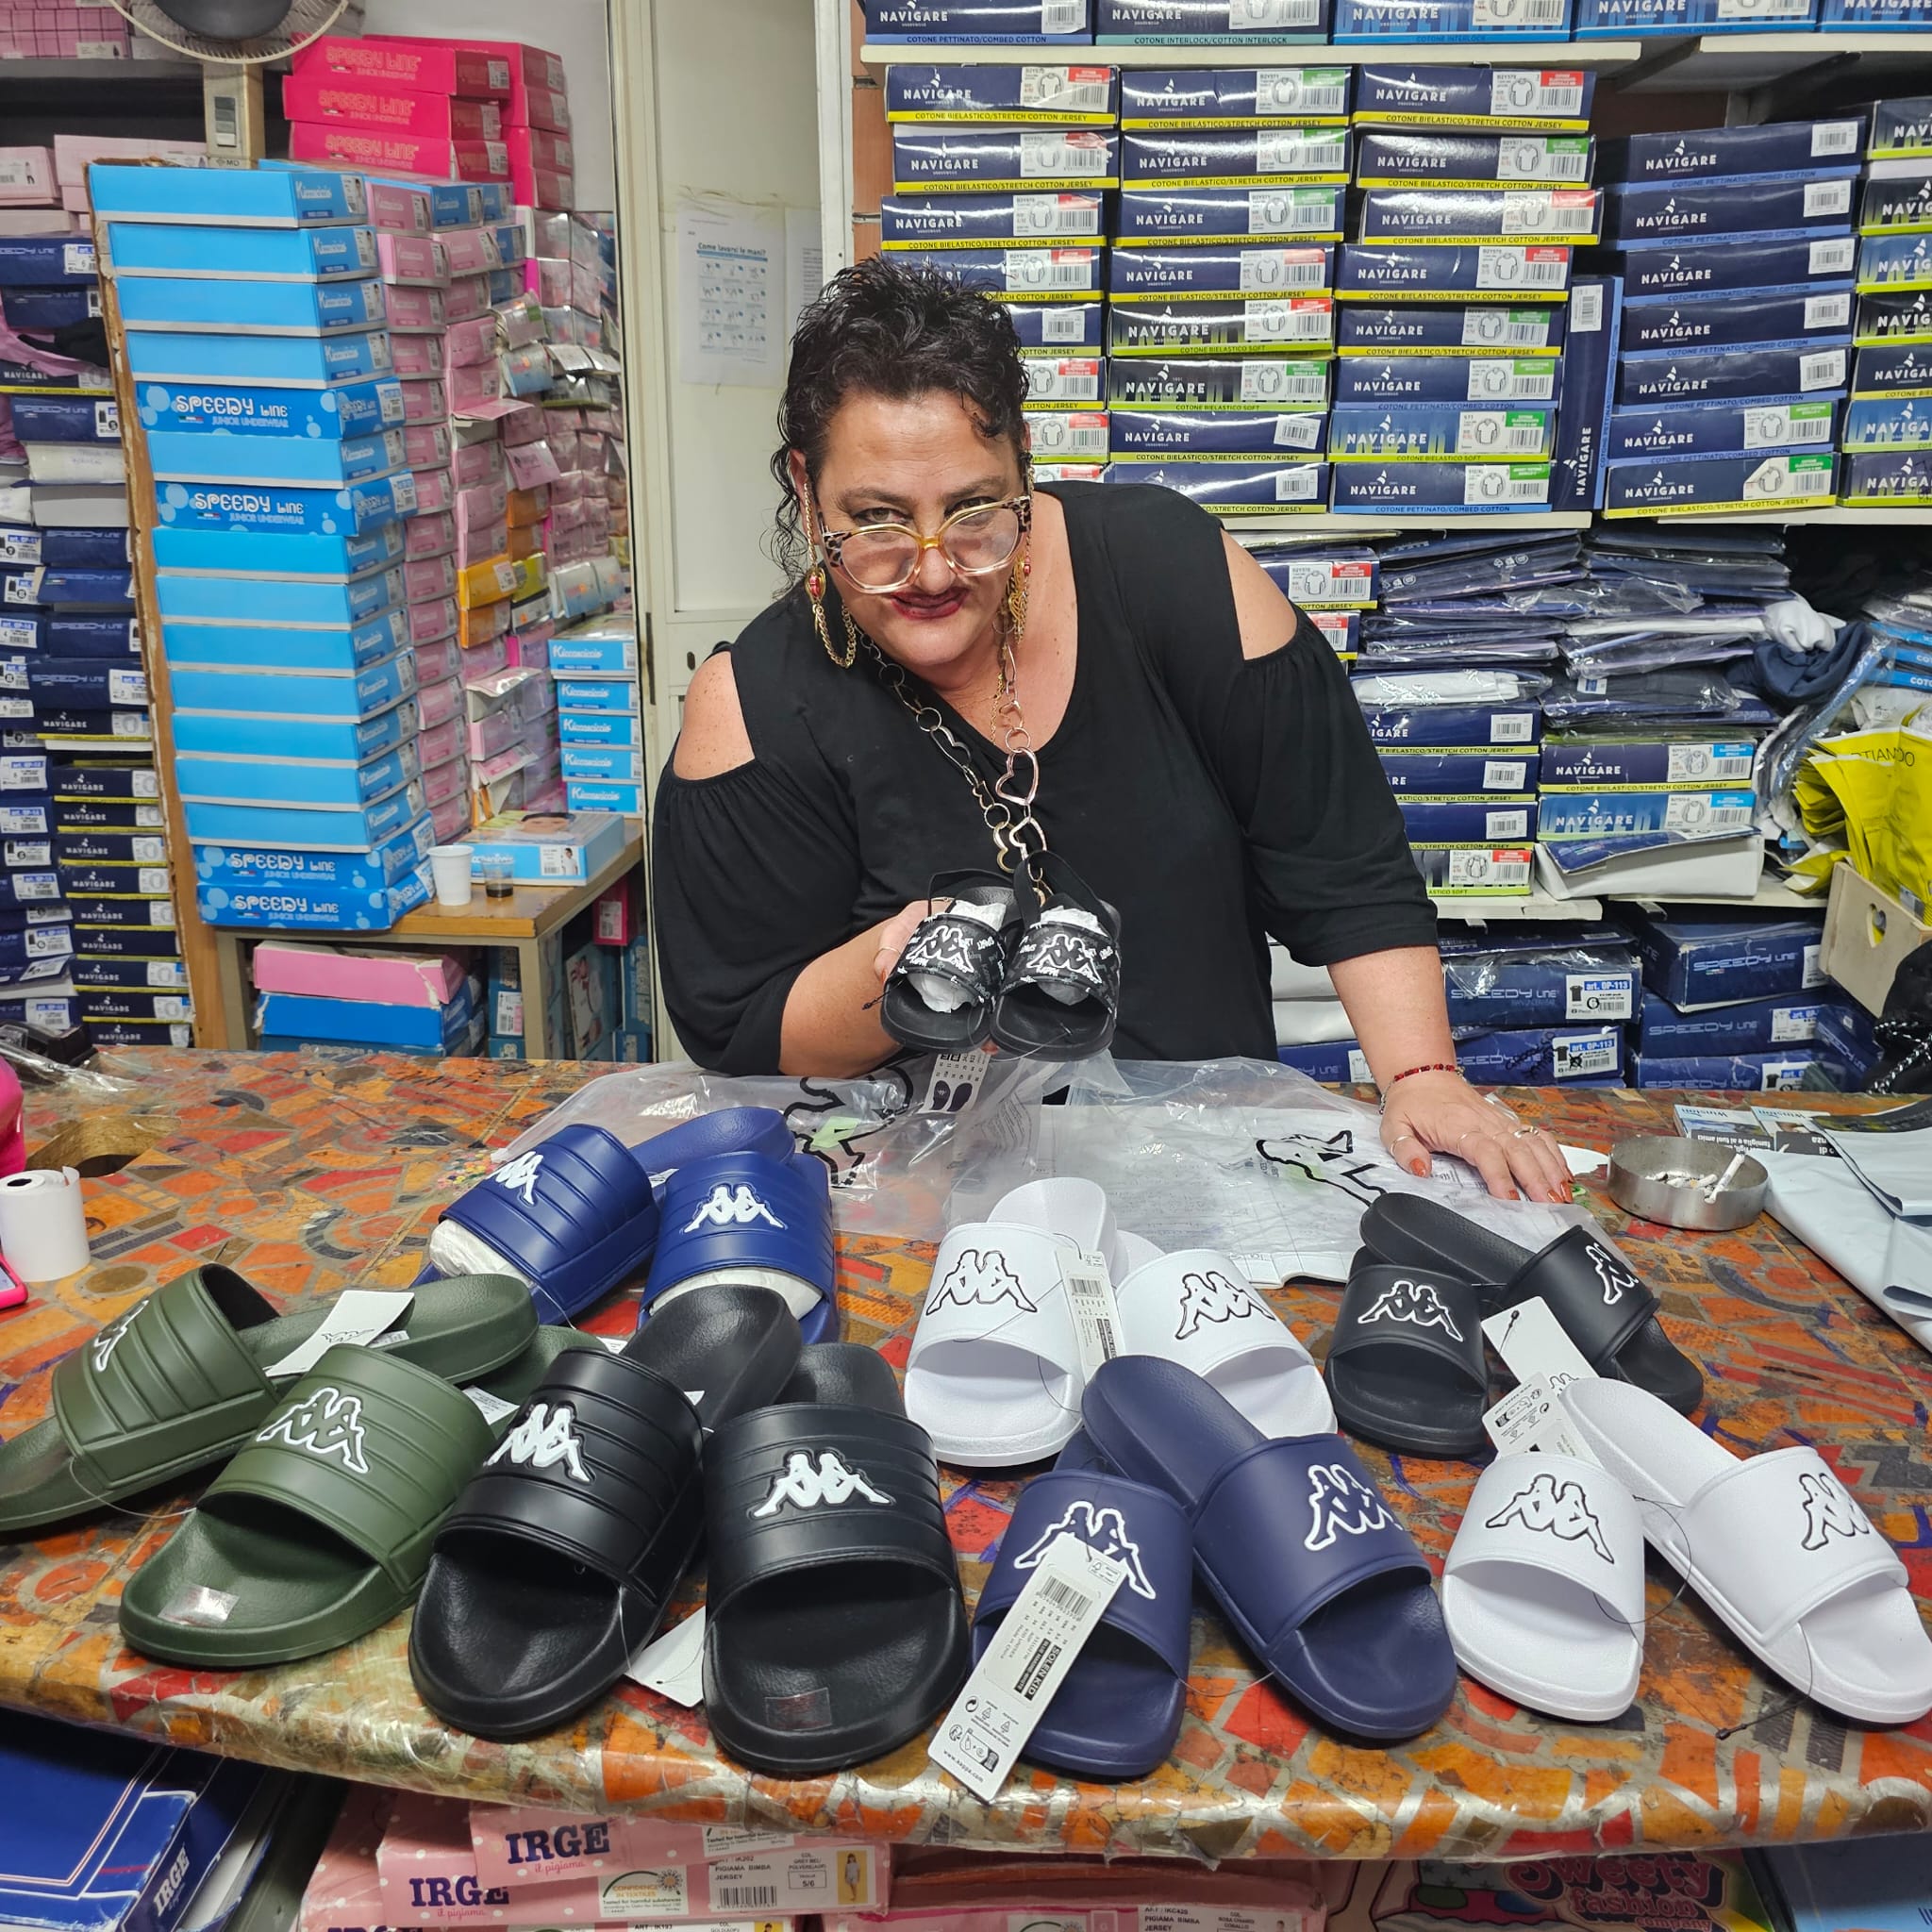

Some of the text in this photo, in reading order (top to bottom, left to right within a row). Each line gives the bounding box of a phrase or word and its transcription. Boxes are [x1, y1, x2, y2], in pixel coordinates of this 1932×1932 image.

[1598, 0, 1687, 13] NAVIGARE
[880, 10, 947, 22] NAVIGARE
[1112, 8, 1182, 20] NAVIGARE
[1353, 7, 1440, 20] NAVIGARE
[907, 35, 939, 43] COTONE
[1019, 35, 1047, 43] COTTON
[903, 89, 972, 100] NAVIGARE
[1375, 89, 1447, 102] NAVIGARE
[1137, 95, 1207, 108] NAVIGARE
[1386, 114, 1563, 128] COTONE BIELASTICO/STRETCH COTTON JERSEY
[910, 158, 979, 170] NAVIGARE
[1139, 157, 1208, 169] NAVIGARE
[1377, 156, 1446, 168] NAVIGARE
[1646, 154, 1717, 171] NAVIGARE
[895, 217, 962, 229] NAVIGARE
[1136, 214, 1204, 225] NAVIGARE
[1381, 214, 1451, 225] NAVIGARE
[1636, 212, 1707, 228] NAVIGARE
[698, 242, 717, 252] Come
[740, 246, 747, 255] le
[748, 247, 766, 256] mani?
[1126, 271, 1193, 282] NAVIGARE
[1357, 268, 1427, 279] NAVIGARE
[1641, 269, 1712, 285] NAVIGARE
[1128, 325, 1209, 338] NAVIGARE
[1356, 325, 1424, 336] NAVIGARE
[1641, 324, 1711, 340] NAVIGARE
[1125, 382, 1206, 394] NAVIGARE
[1354, 380, 1421, 392] NAVIGARE
[1639, 379, 1708, 395] NAVIGARE
[175, 395, 253, 416] SPEEDY
[1866, 422, 1929, 435] NAVIGA
[1124, 432, 1191, 442] NAVIGARE
[1347, 432, 1427, 445] NAVIGARE
[1624, 433, 1694, 448] NAVIGARE
[1167, 454, 1242, 462] BIELASTICO/STRETCH
[1574, 425, 1591, 495] NAVIGARE
[1350, 485, 1417, 496] NAVIGARE
[1625, 484, 1695, 499] NAVIGARE
[193, 493, 271, 513] SPEEDY
[1405, 506, 1474, 514] PETTINATO/COMBED
[1476, 505, 1510, 513] COTTON
[1556, 765, 1622, 775] NAVIGARE
[1698, 782, 1728, 791] JERSEY
[1556, 813, 1634, 826] NAVIGARE
[230, 854, 304, 871] SPEEDY
[236, 895, 308, 912] SPEEDY
[1693, 954, 1772, 972] SPEEDY
[1649, 1022, 1734, 1036] SPEEDY
[1682, 1107, 1728, 1118] Winston
[1040, 1645, 1060, 1678] SOLEN
[1026, 1676, 1042, 1696] KID
[942, 1749, 985, 1783] www.kappa.com
[506, 1822, 609, 1864] IRGE
[545, 1859, 585, 1874] pigiama
[153, 1846, 190, 1917] IRGE
[802, 1879, 816, 1888] 5/6
[1507, 1856, 1714, 1900] Sweety
[409, 1875, 510, 1907] IRGE
[1570, 1885, 1700, 1921] fashion
[447, 1908, 485, 1920] pigiama
[1636, 1916, 1713, 1931] company
